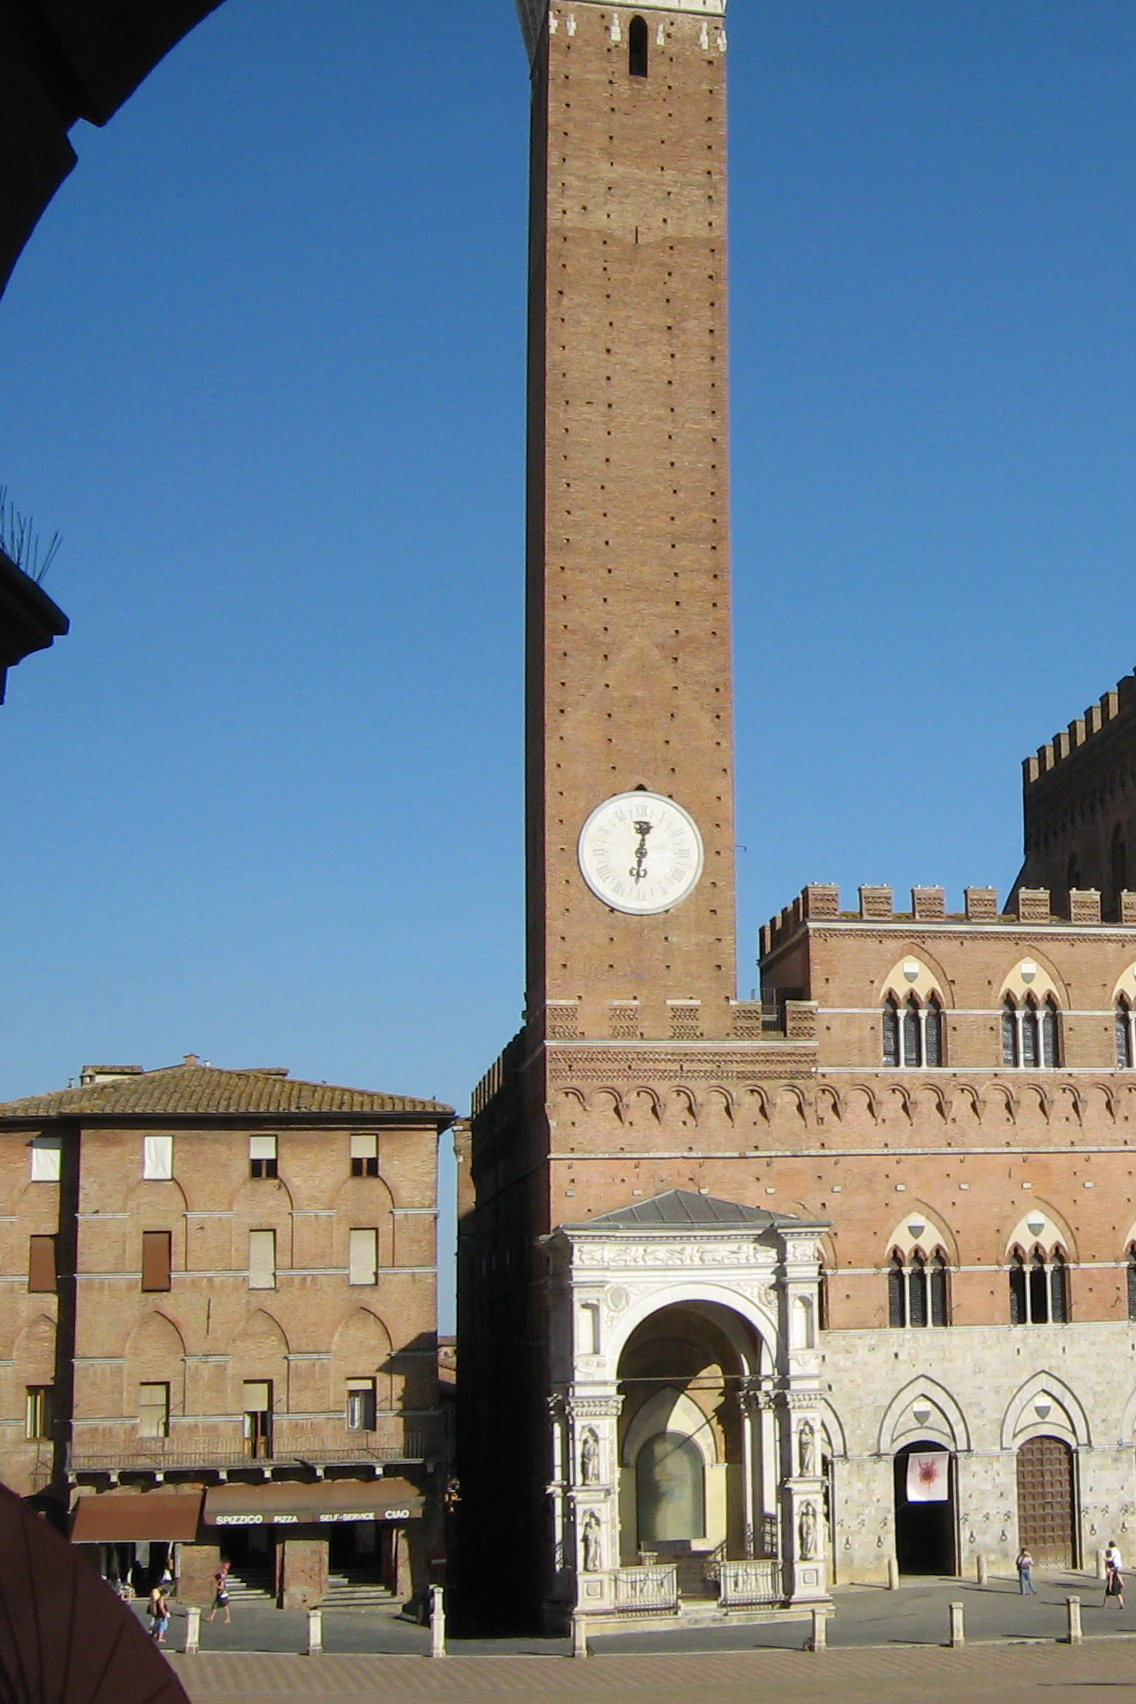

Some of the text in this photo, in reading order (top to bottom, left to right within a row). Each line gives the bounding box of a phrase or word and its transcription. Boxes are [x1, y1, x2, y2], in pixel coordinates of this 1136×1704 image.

[215, 1509, 410, 1525] SPIZZICO PIZZA SELF-SERVICE CIAO
